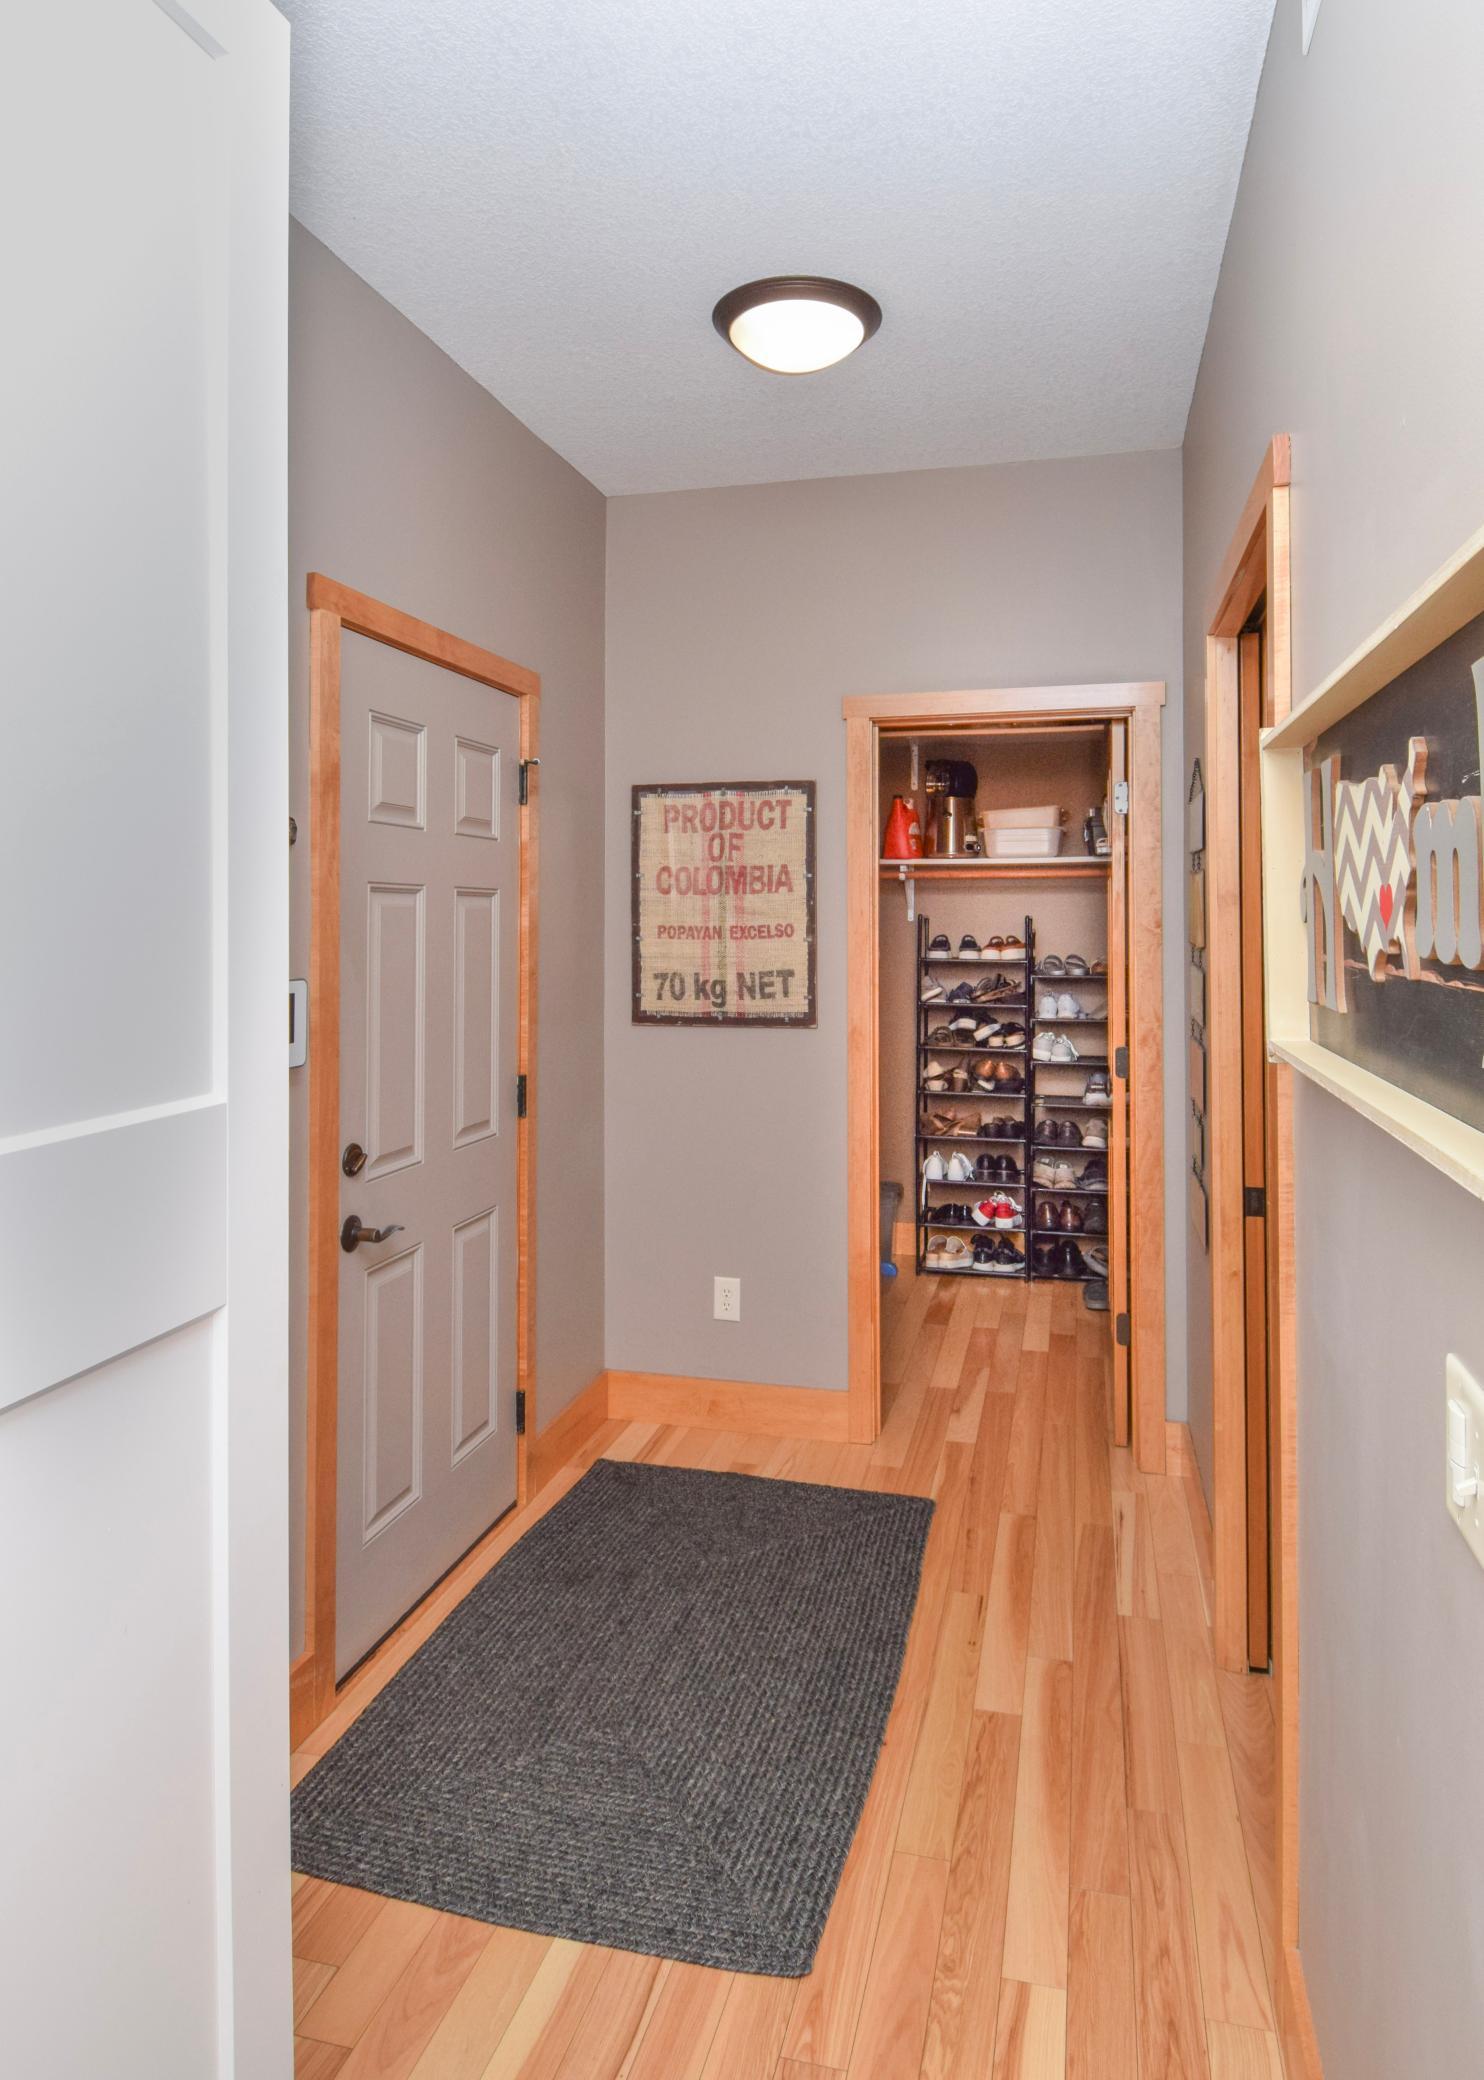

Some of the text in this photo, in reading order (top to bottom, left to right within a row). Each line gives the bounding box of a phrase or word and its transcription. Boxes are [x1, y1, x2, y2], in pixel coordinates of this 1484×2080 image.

[663, 799, 793, 834] PRODUCT
[707, 832, 745, 863] OF
[655, 863, 794, 896] COLOMBIA
[657, 923, 795, 940] POPAYAN EXCELSO
[653, 969, 795, 1009] 70 kg NET
